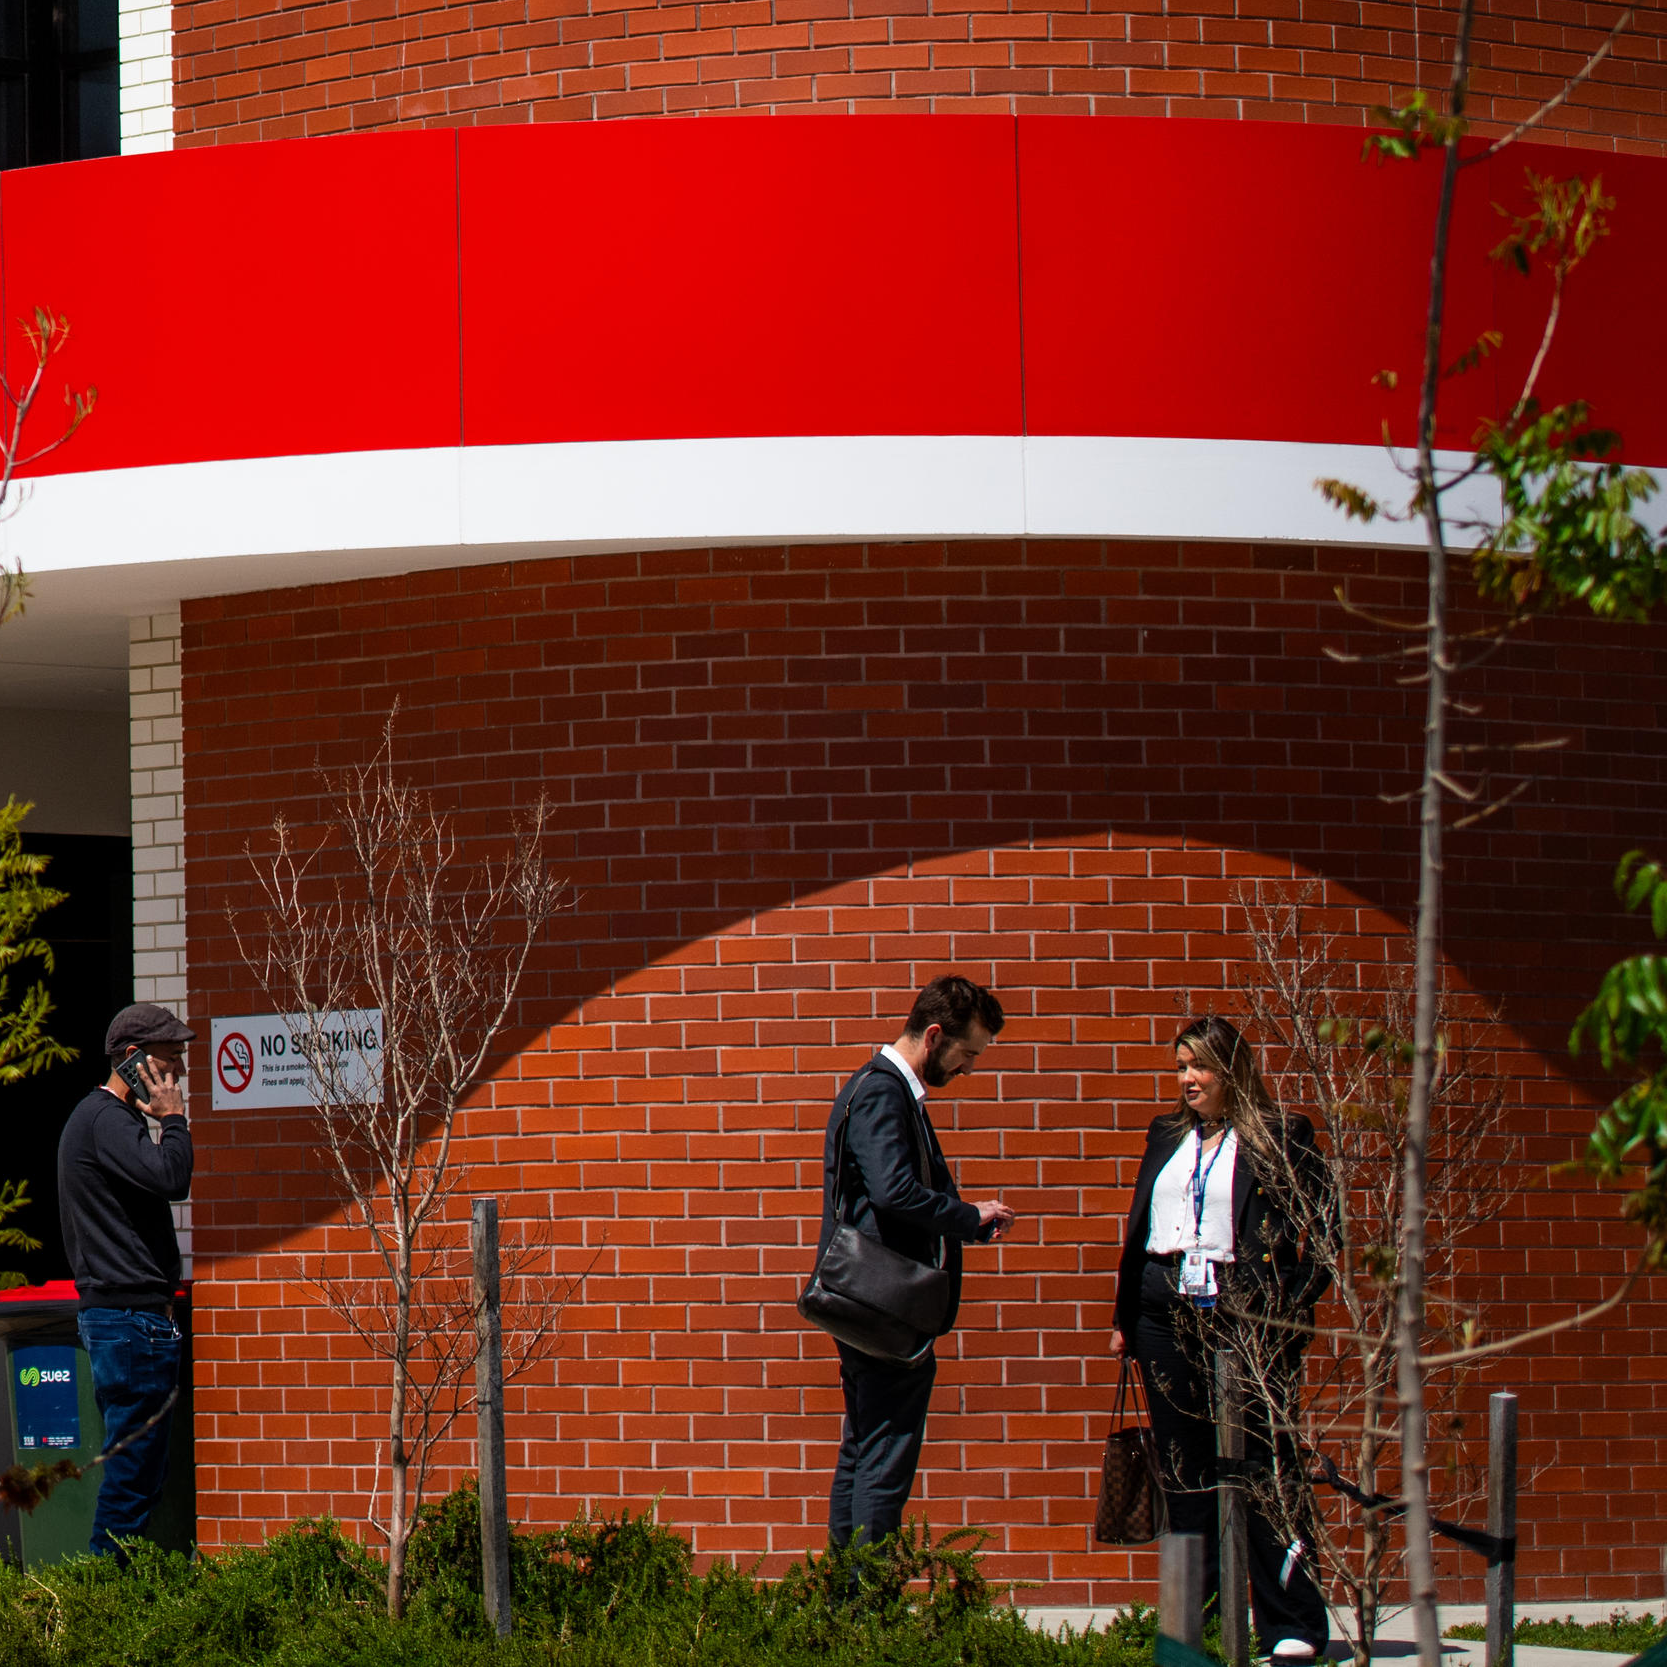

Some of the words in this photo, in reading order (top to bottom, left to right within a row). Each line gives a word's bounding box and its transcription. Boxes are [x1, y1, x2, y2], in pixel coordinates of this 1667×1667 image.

[260, 1034, 286, 1056] NO
[262, 1064, 274, 1072] This
[261, 1078, 277, 1086] Fines
[278, 1077, 288, 1085] will
[40, 1370, 71, 1382] suez
